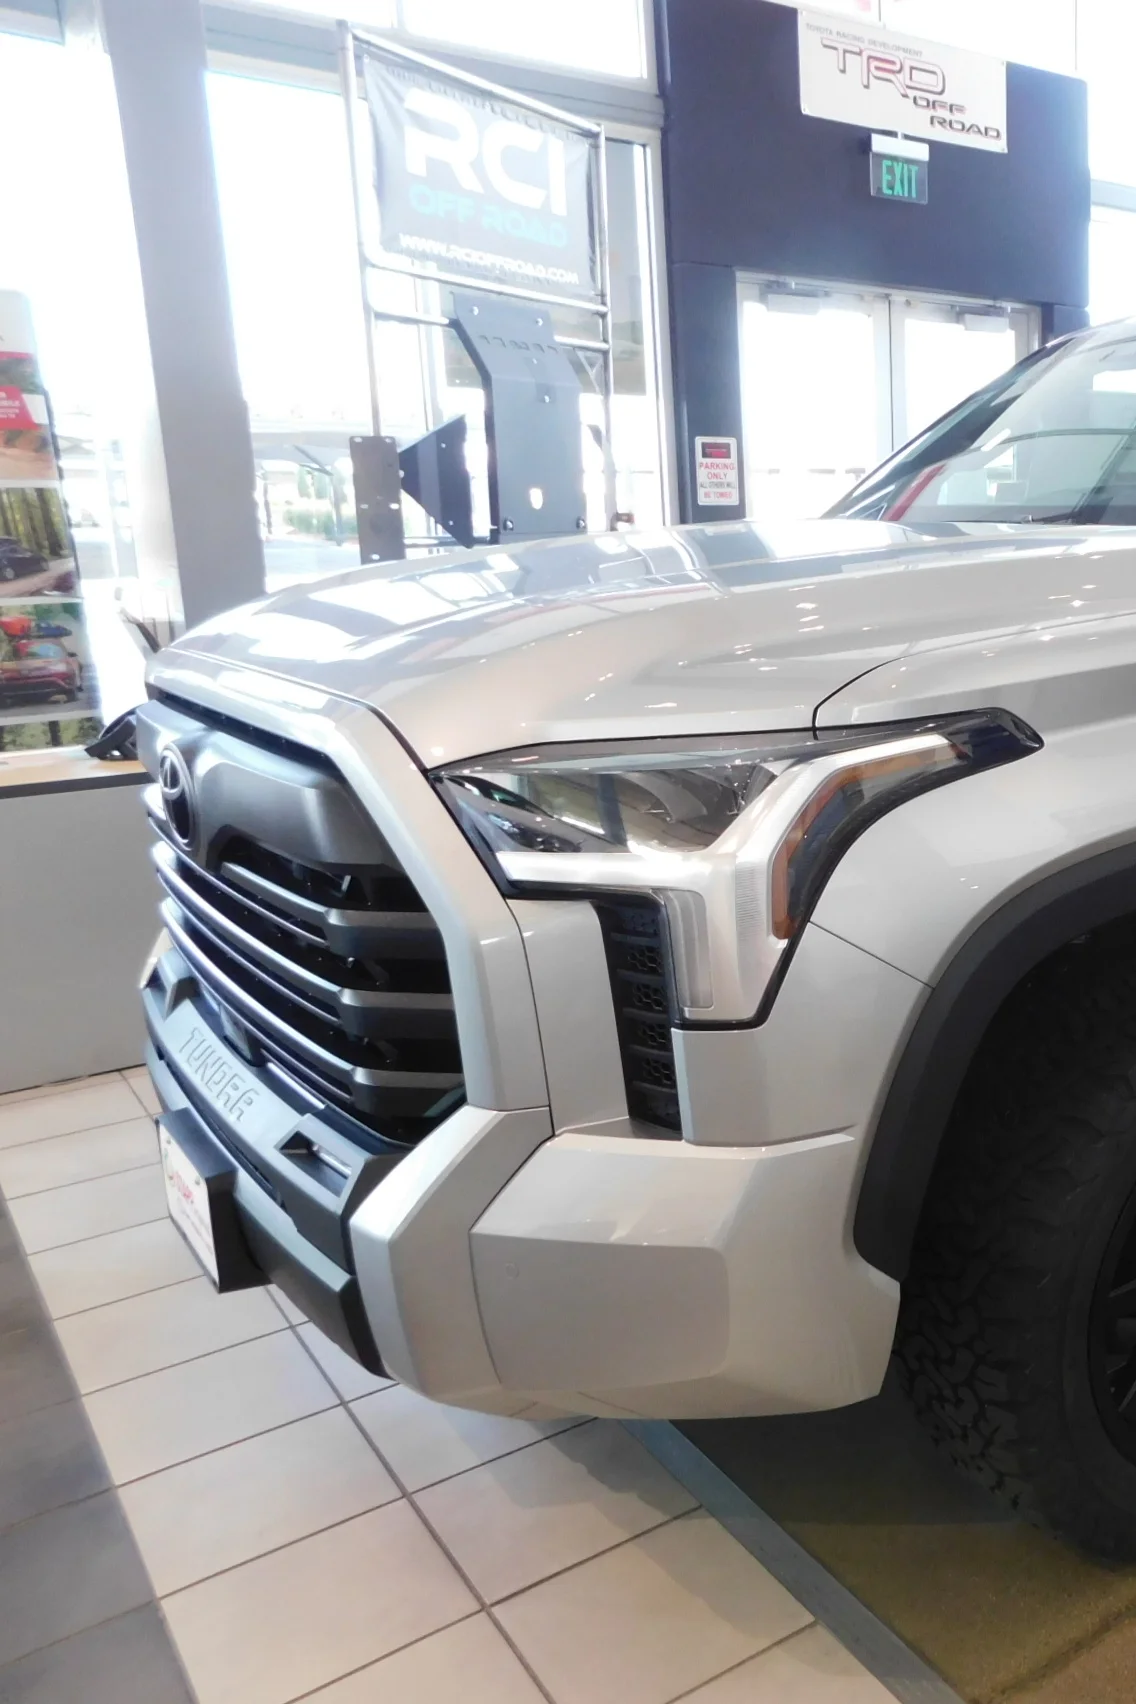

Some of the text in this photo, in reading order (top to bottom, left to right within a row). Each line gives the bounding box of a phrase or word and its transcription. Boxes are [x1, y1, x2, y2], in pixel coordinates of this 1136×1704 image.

[805, 22, 924, 58] TOYOTA RACING DEVELOPMENT
[820, 37, 946, 99] TRD
[912, 95, 967, 116] OFF
[930, 115, 1002, 141] ROAD
[403, 87, 568, 217] RCI
[881, 159, 919, 198] EXIT
[409, 184, 570, 248] OFF ROAD
[699, 462, 736, 471] PARKING
[707, 472, 729, 480] ONLY
[713, 491, 733, 499] TOWED
